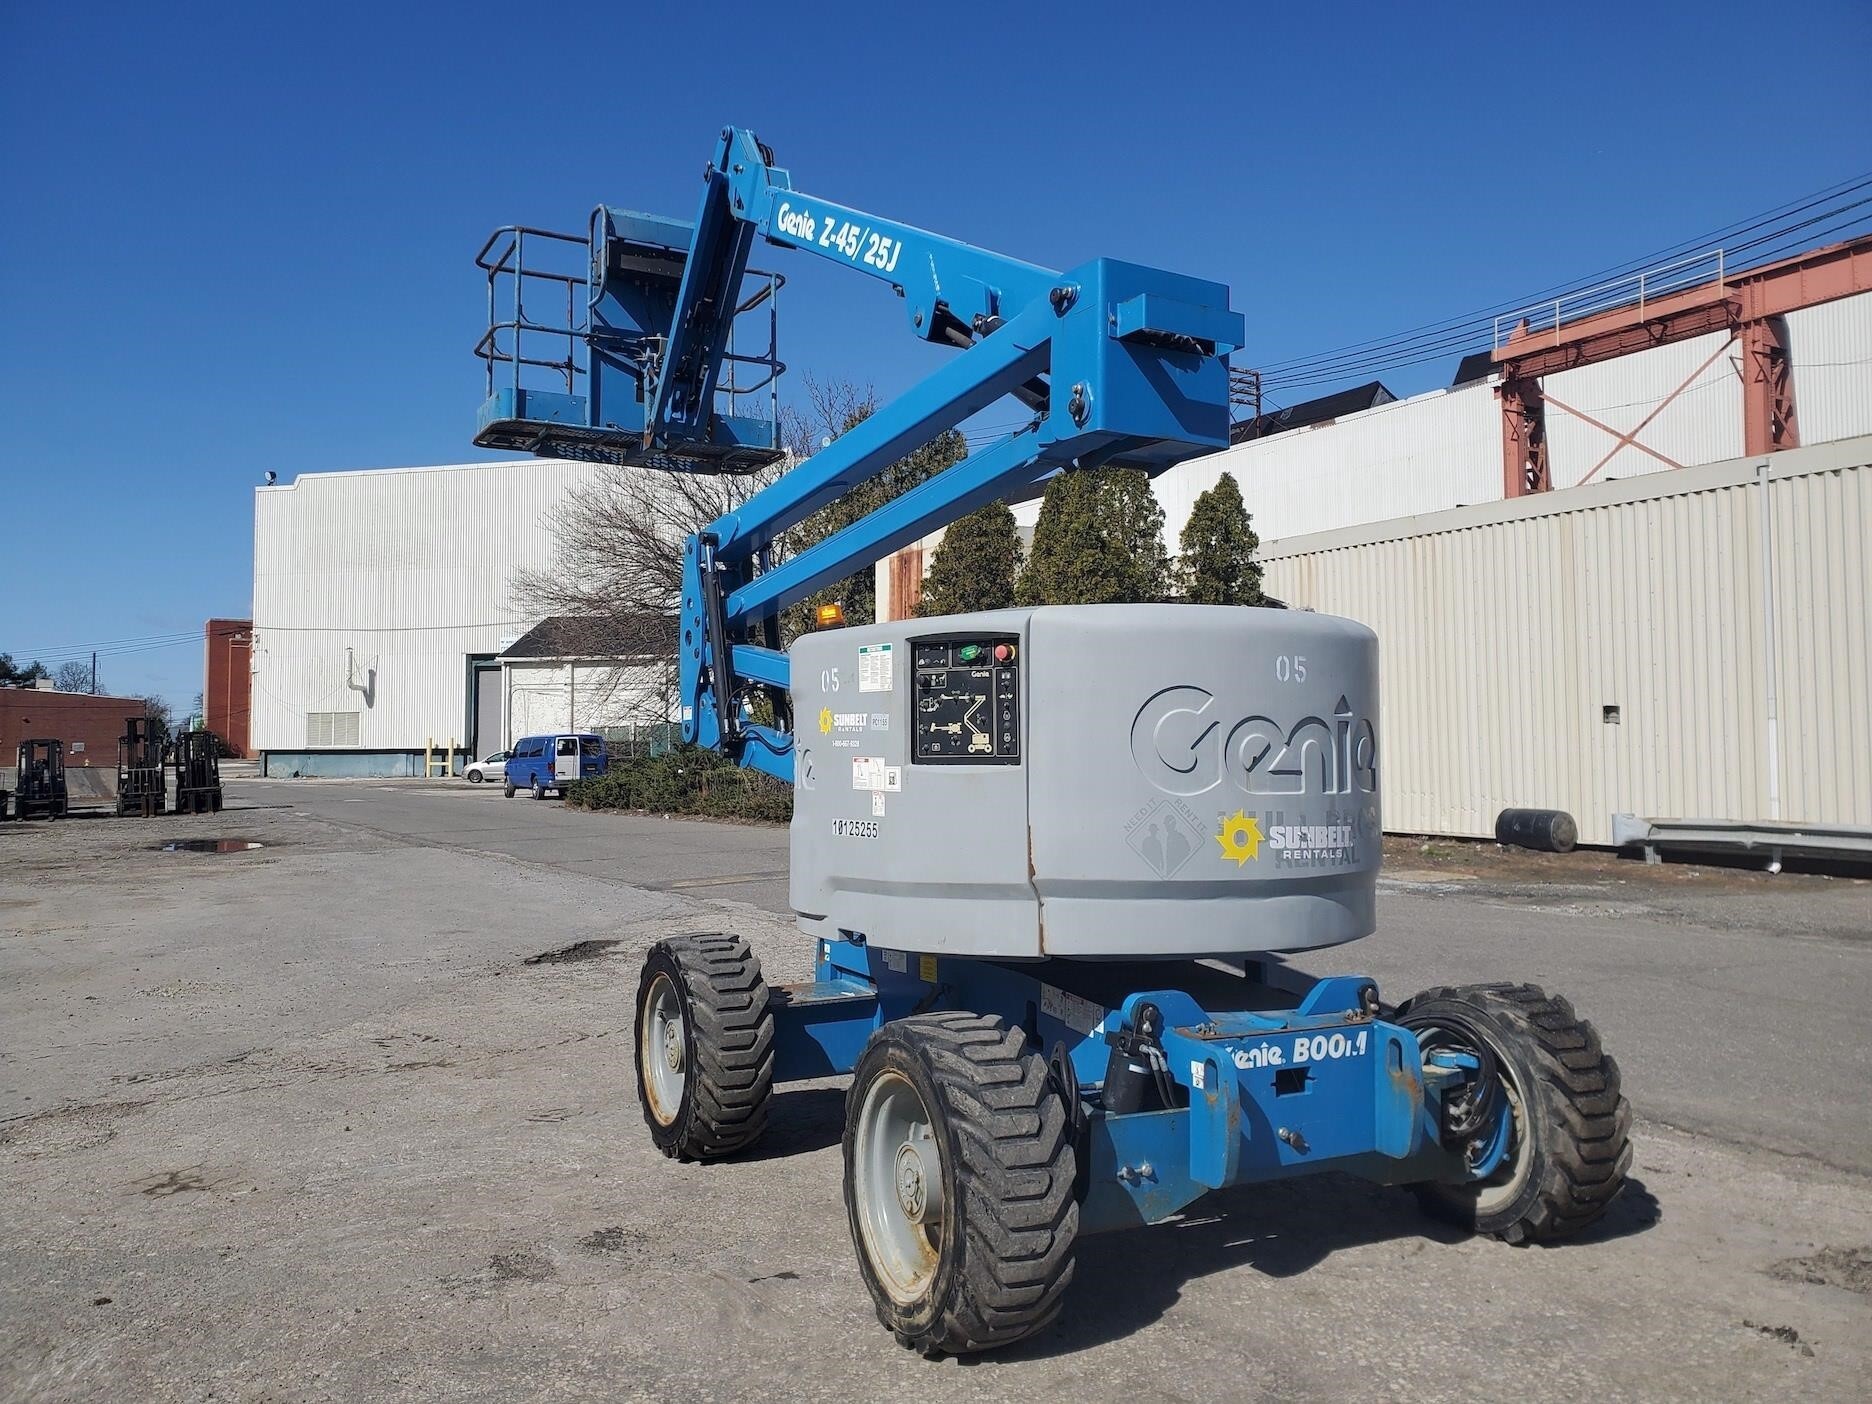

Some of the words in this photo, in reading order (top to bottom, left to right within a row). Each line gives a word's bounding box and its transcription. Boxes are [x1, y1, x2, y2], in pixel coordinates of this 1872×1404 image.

[778, 202, 816, 242] Genie
[821, 667, 840, 693] 05
[971, 670, 990, 678] Genie
[1276, 655, 1307, 683] 05
[833, 713, 868, 727] SUNBELT
[1131, 685, 1376, 796] Genie
[832, 820, 879, 839] 10125255
[1269, 825, 1352, 849] SUNBELT
[1283, 849, 1343, 860] RENTALS
